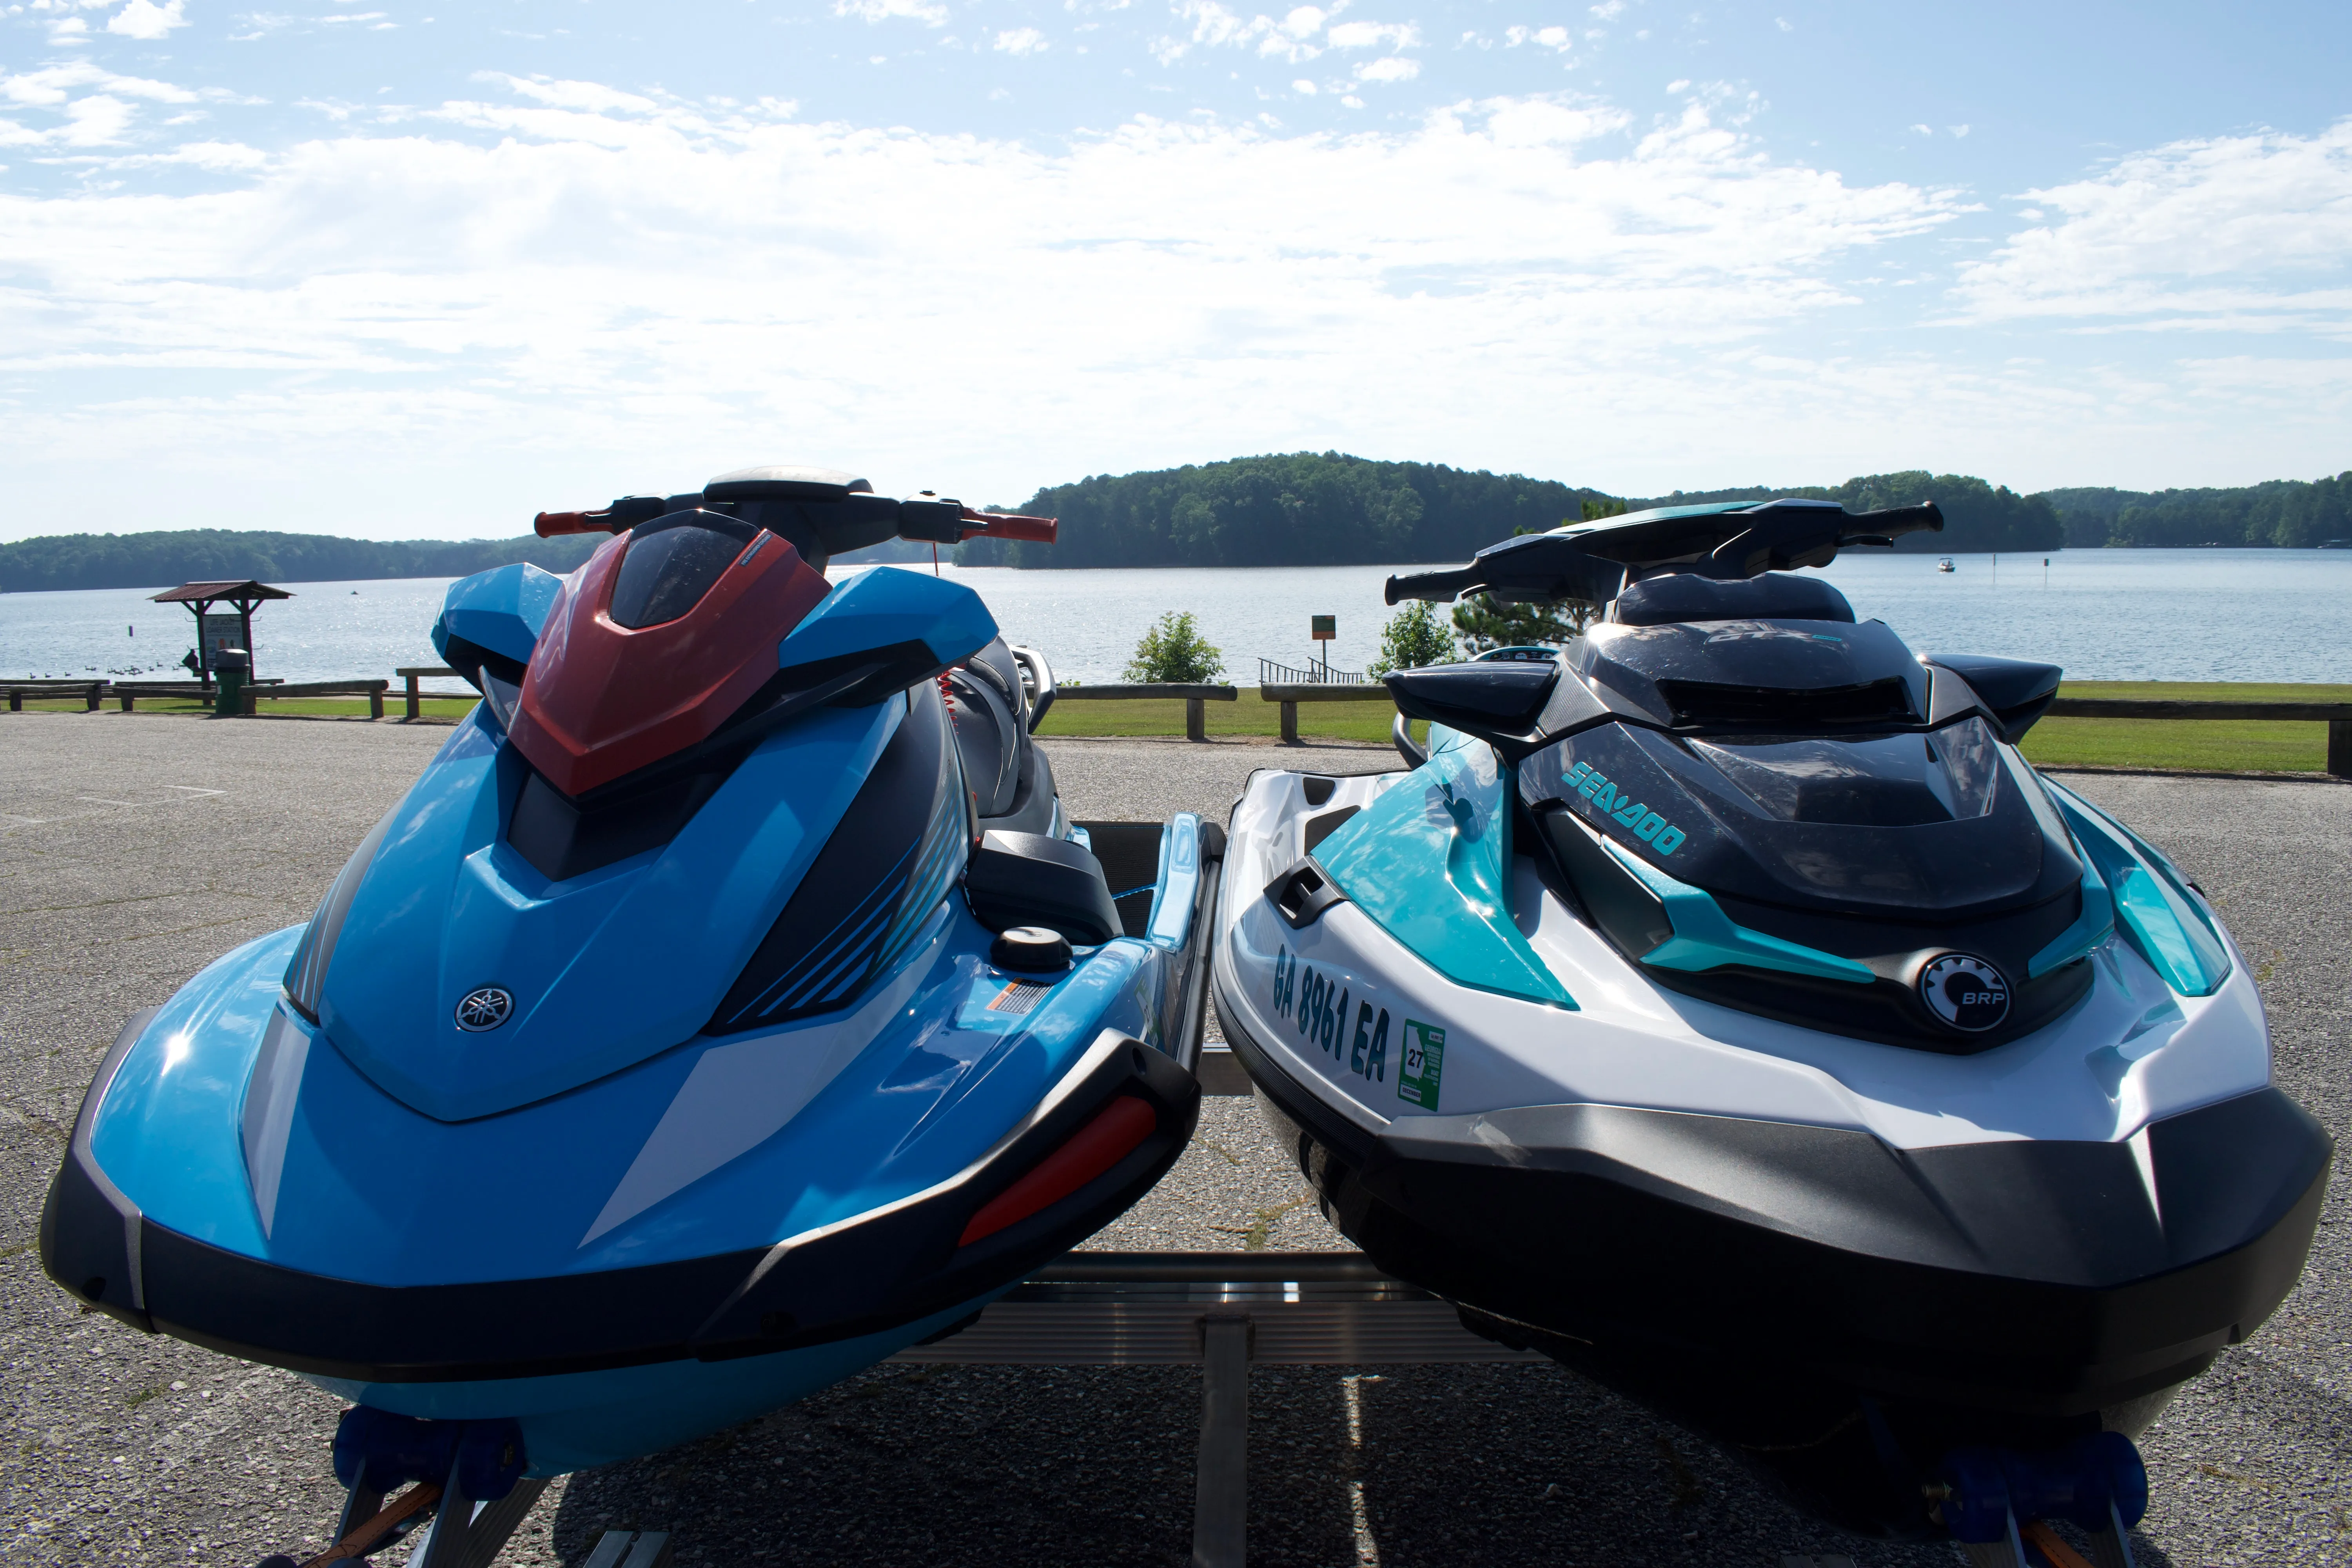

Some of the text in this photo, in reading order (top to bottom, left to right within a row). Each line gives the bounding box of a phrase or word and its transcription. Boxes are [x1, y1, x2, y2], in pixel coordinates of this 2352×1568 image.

[1707, 631, 1811, 643] GTX
[1962, 993, 2005, 1005] BRP
[1144, 1004, 1151, 1023] 27
[1274, 943, 1390, 1082] GA 8961 EA
[1425, 1044, 1441, 1055] GEORGIA
[1408, 1048, 1423, 1069] 27
[1402, 1087, 1421, 1098] DECEMBER
